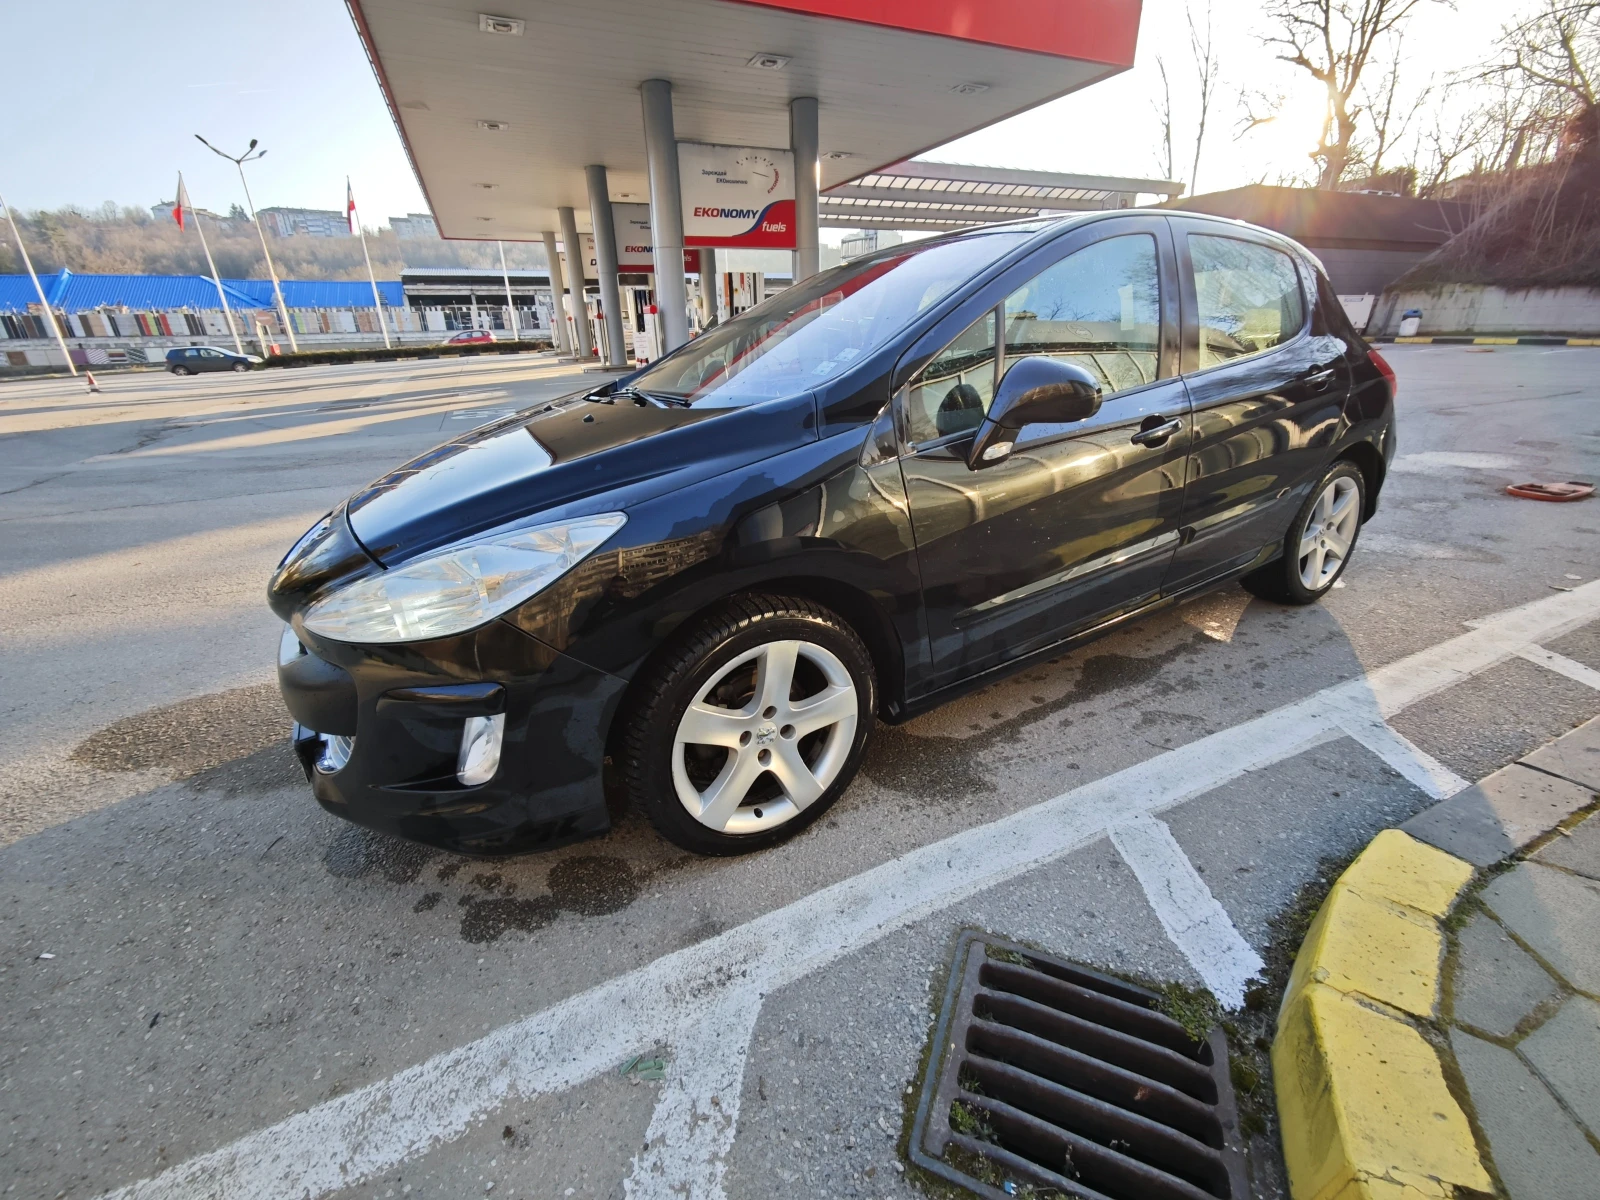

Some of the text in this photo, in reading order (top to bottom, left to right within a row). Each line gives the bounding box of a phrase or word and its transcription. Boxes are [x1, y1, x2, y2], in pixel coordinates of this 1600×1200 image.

[767, 168, 780, 194] EKONOMY
[693, 206, 760, 220] EKONOMY
[761, 221, 787, 233] fuels
[624, 245, 653, 253] EKON
